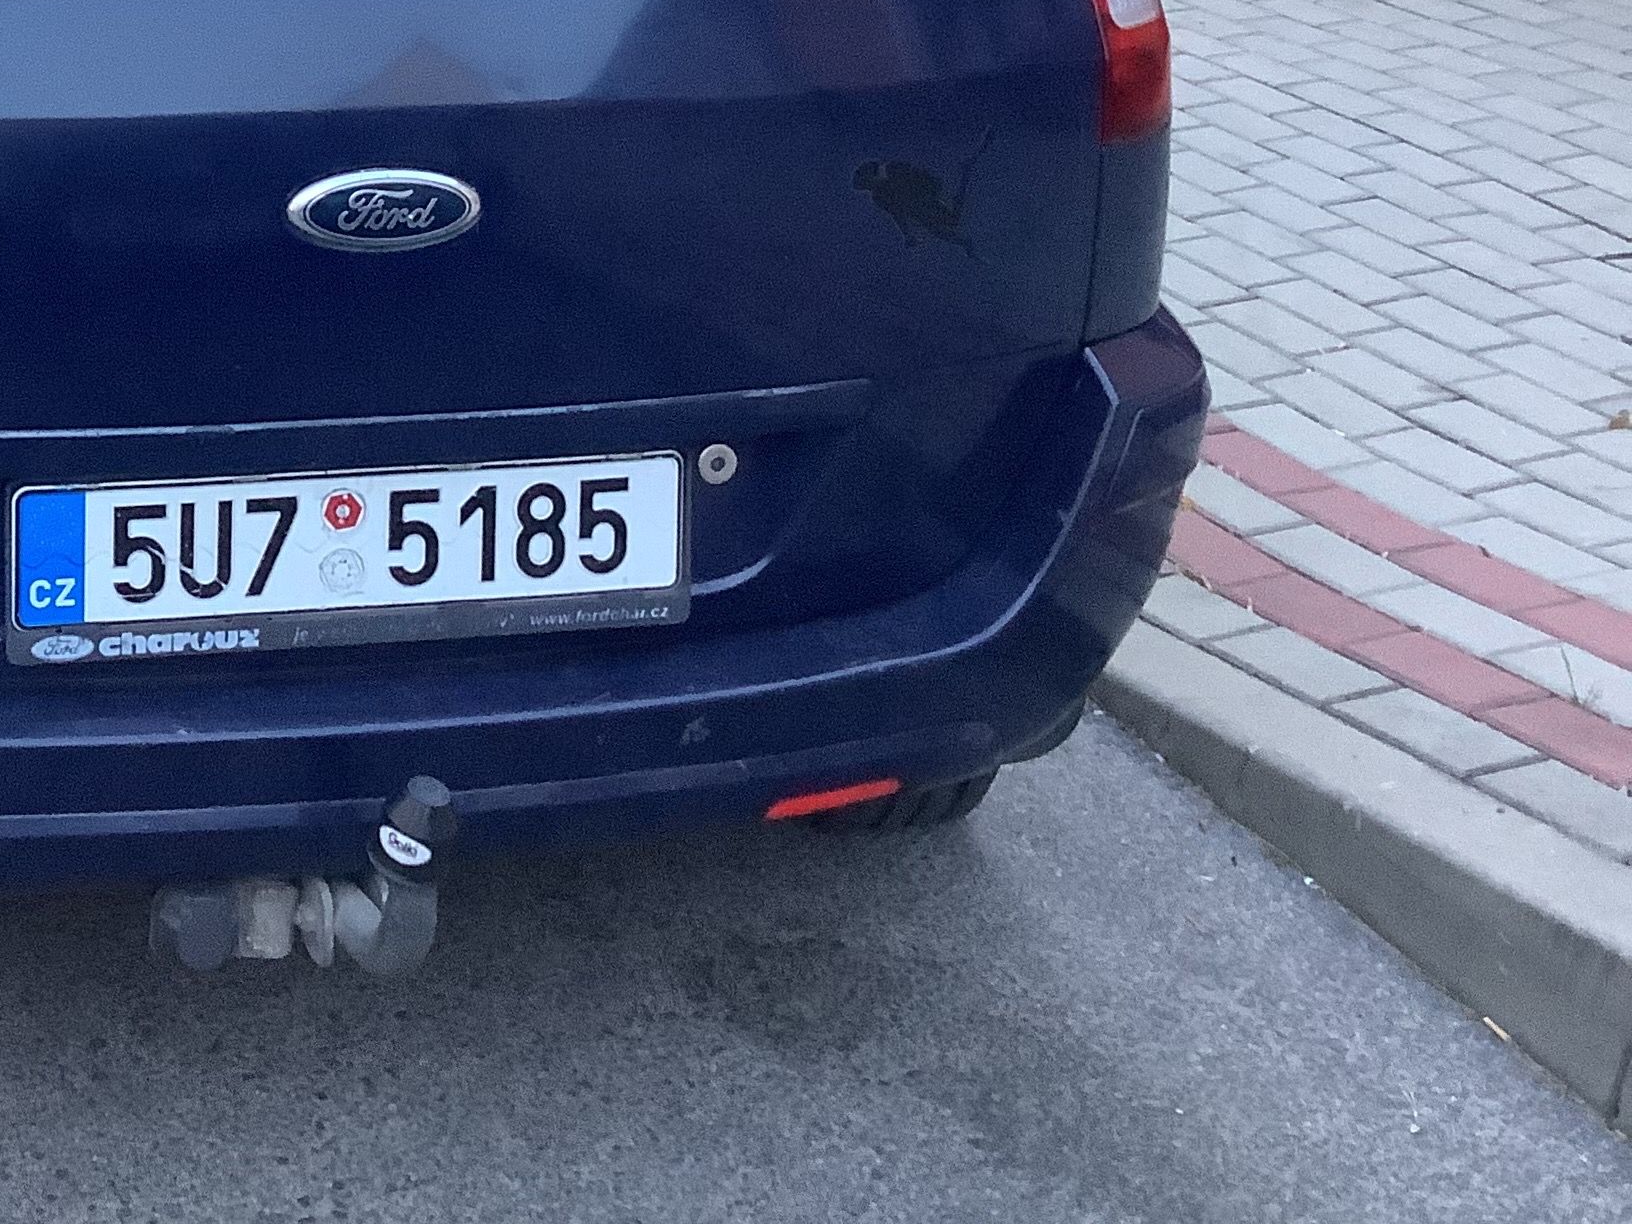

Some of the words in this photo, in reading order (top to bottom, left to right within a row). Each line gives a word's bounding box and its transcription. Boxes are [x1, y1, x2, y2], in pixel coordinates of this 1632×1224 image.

[337, 189, 438, 231] Ford
[113, 496, 298, 604] 5U7
[388, 477, 629, 587] 5185
[29, 577, 76, 609] CZ
